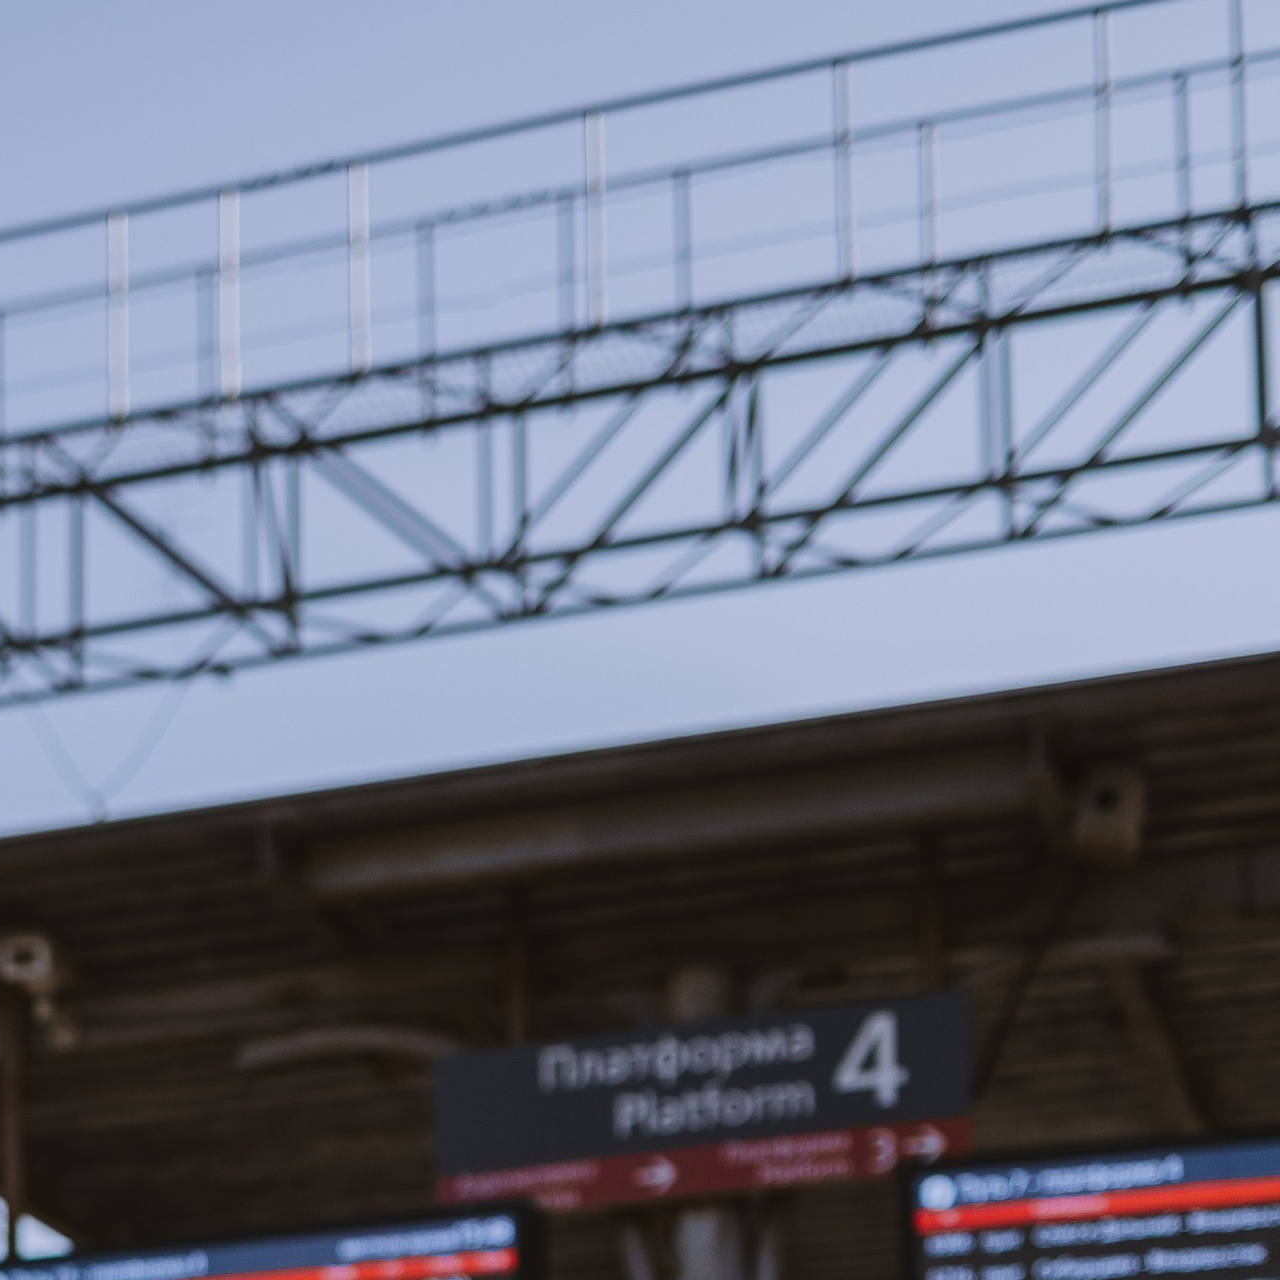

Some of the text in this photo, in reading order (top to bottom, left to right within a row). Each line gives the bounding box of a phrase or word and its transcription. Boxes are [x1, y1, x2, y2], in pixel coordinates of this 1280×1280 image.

[537, 1009, 910, 1109] Платформа 4
[612, 1080, 817, 1139] Platform
